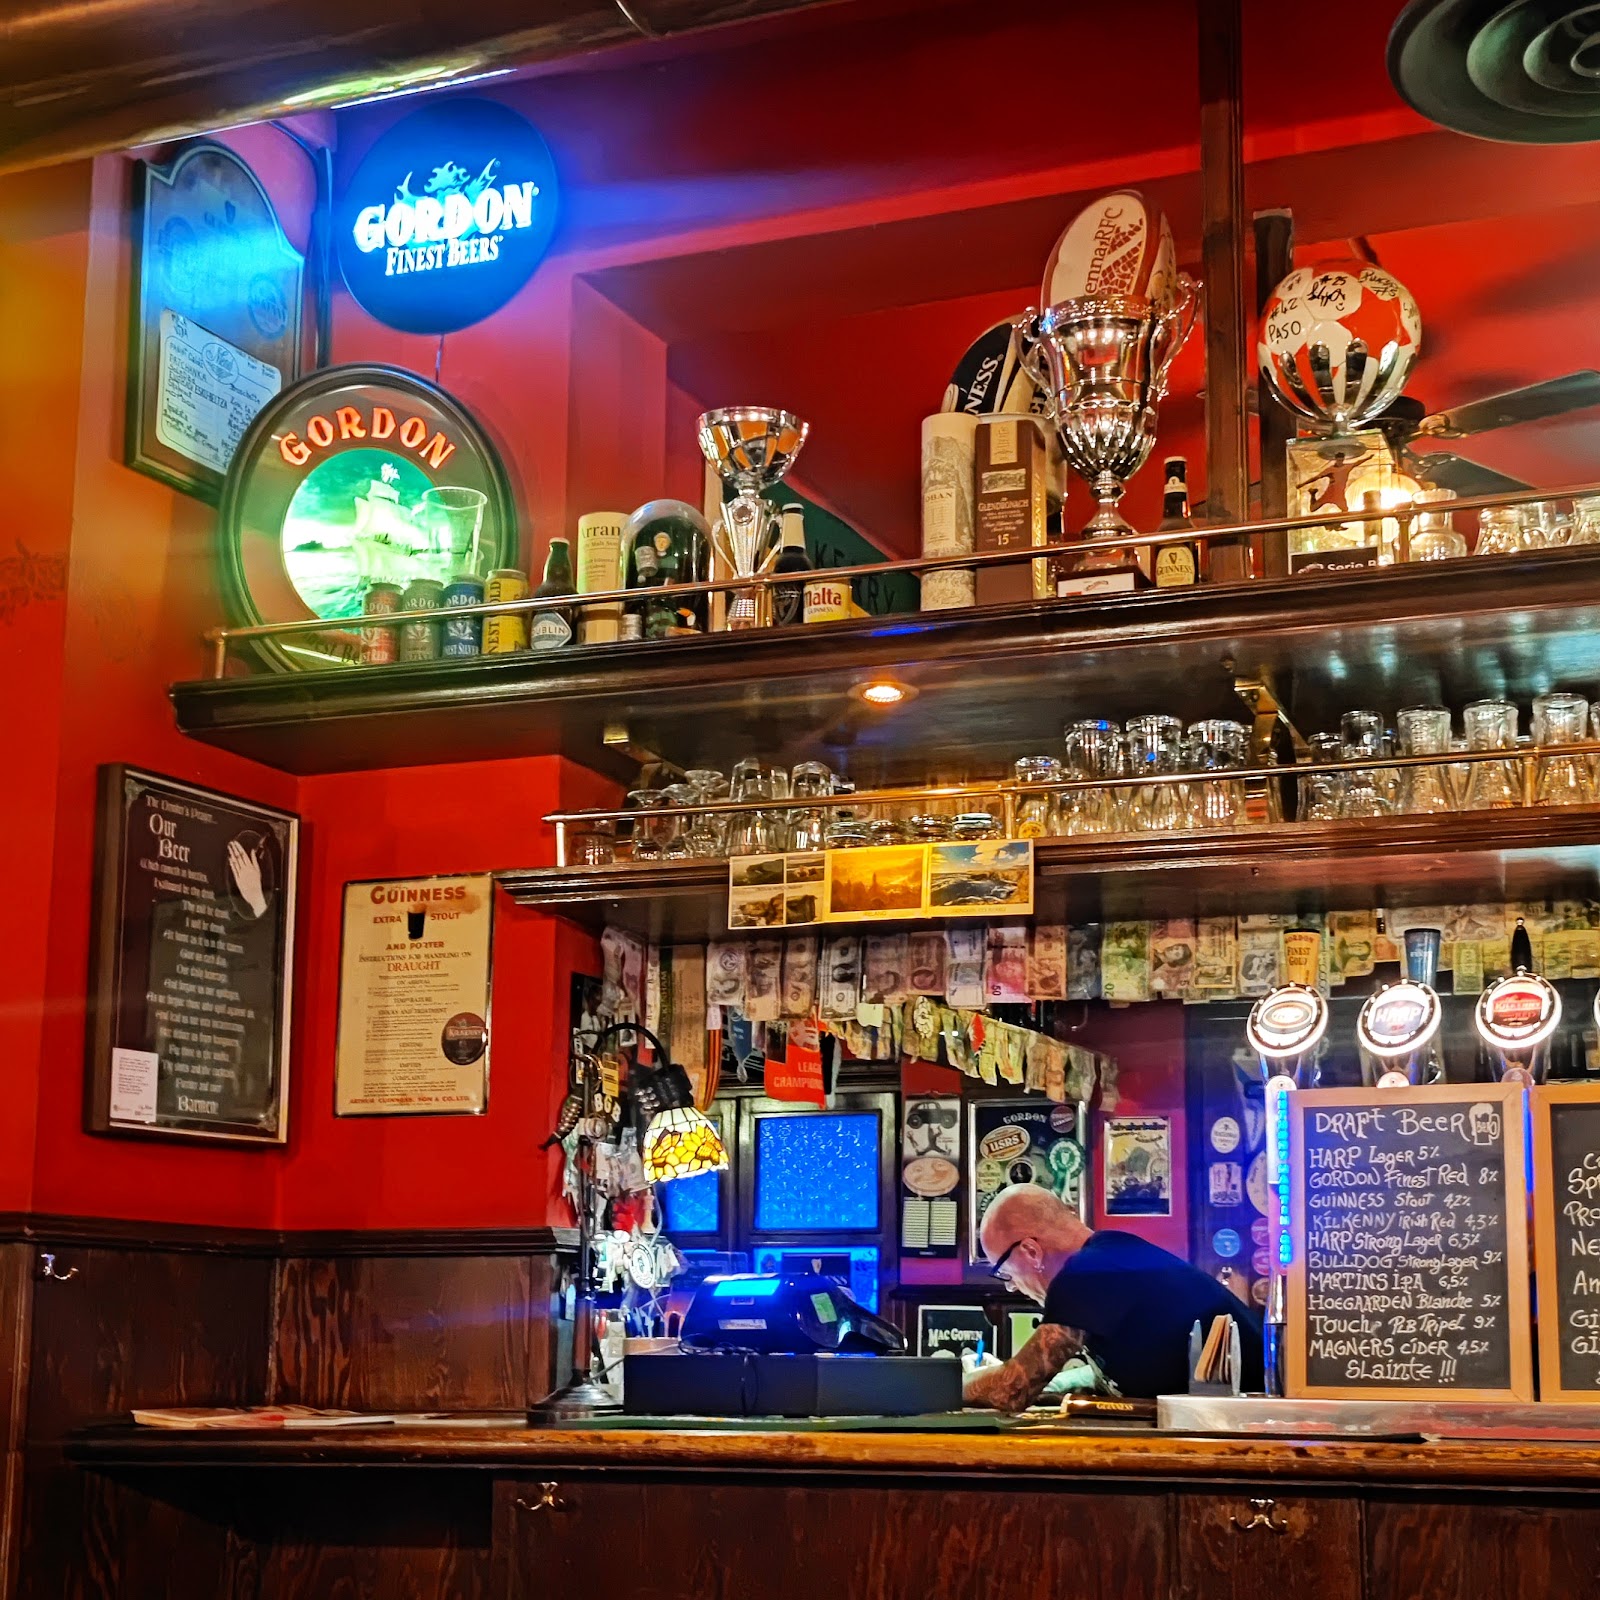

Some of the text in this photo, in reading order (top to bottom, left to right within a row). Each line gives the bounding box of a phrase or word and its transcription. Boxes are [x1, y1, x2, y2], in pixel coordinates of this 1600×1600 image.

[353, 181, 534, 252] GORDON
[385, 236, 499, 276] FINEST BEERS
[280, 406, 456, 469] GORDON
[997, 533, 1010, 546] 15
[1157, 564, 1193, 575] GUINNESS
[370, 885, 467, 905] GUINNESS
[373, 912, 461, 924] EXTRA STOUT
[385, 941, 445, 951] AND PORTER
[387, 961, 441, 972] DRAUGHT
[1376, 1005, 1420, 1024] HARP
[1002, 1112, 1048, 1124] GORDON
[1309, 1147, 1361, 1169] HARP
[1417, 1145, 1440, 1161] 5%
[1309, 1167, 1380, 1188] GORDON
[1479, 1167, 1499, 1185] 8%
[1308, 1231, 1353, 1255] HARP
[1308, 1251, 1393, 1269] BULLDOG
[1481, 1250, 1503, 1265] 9%
[1480, 1294, 1502, 1309] 5%
[1473, 1314, 1496, 1329] 9%
[1309, 1338, 1395, 1360] MAGNERS
